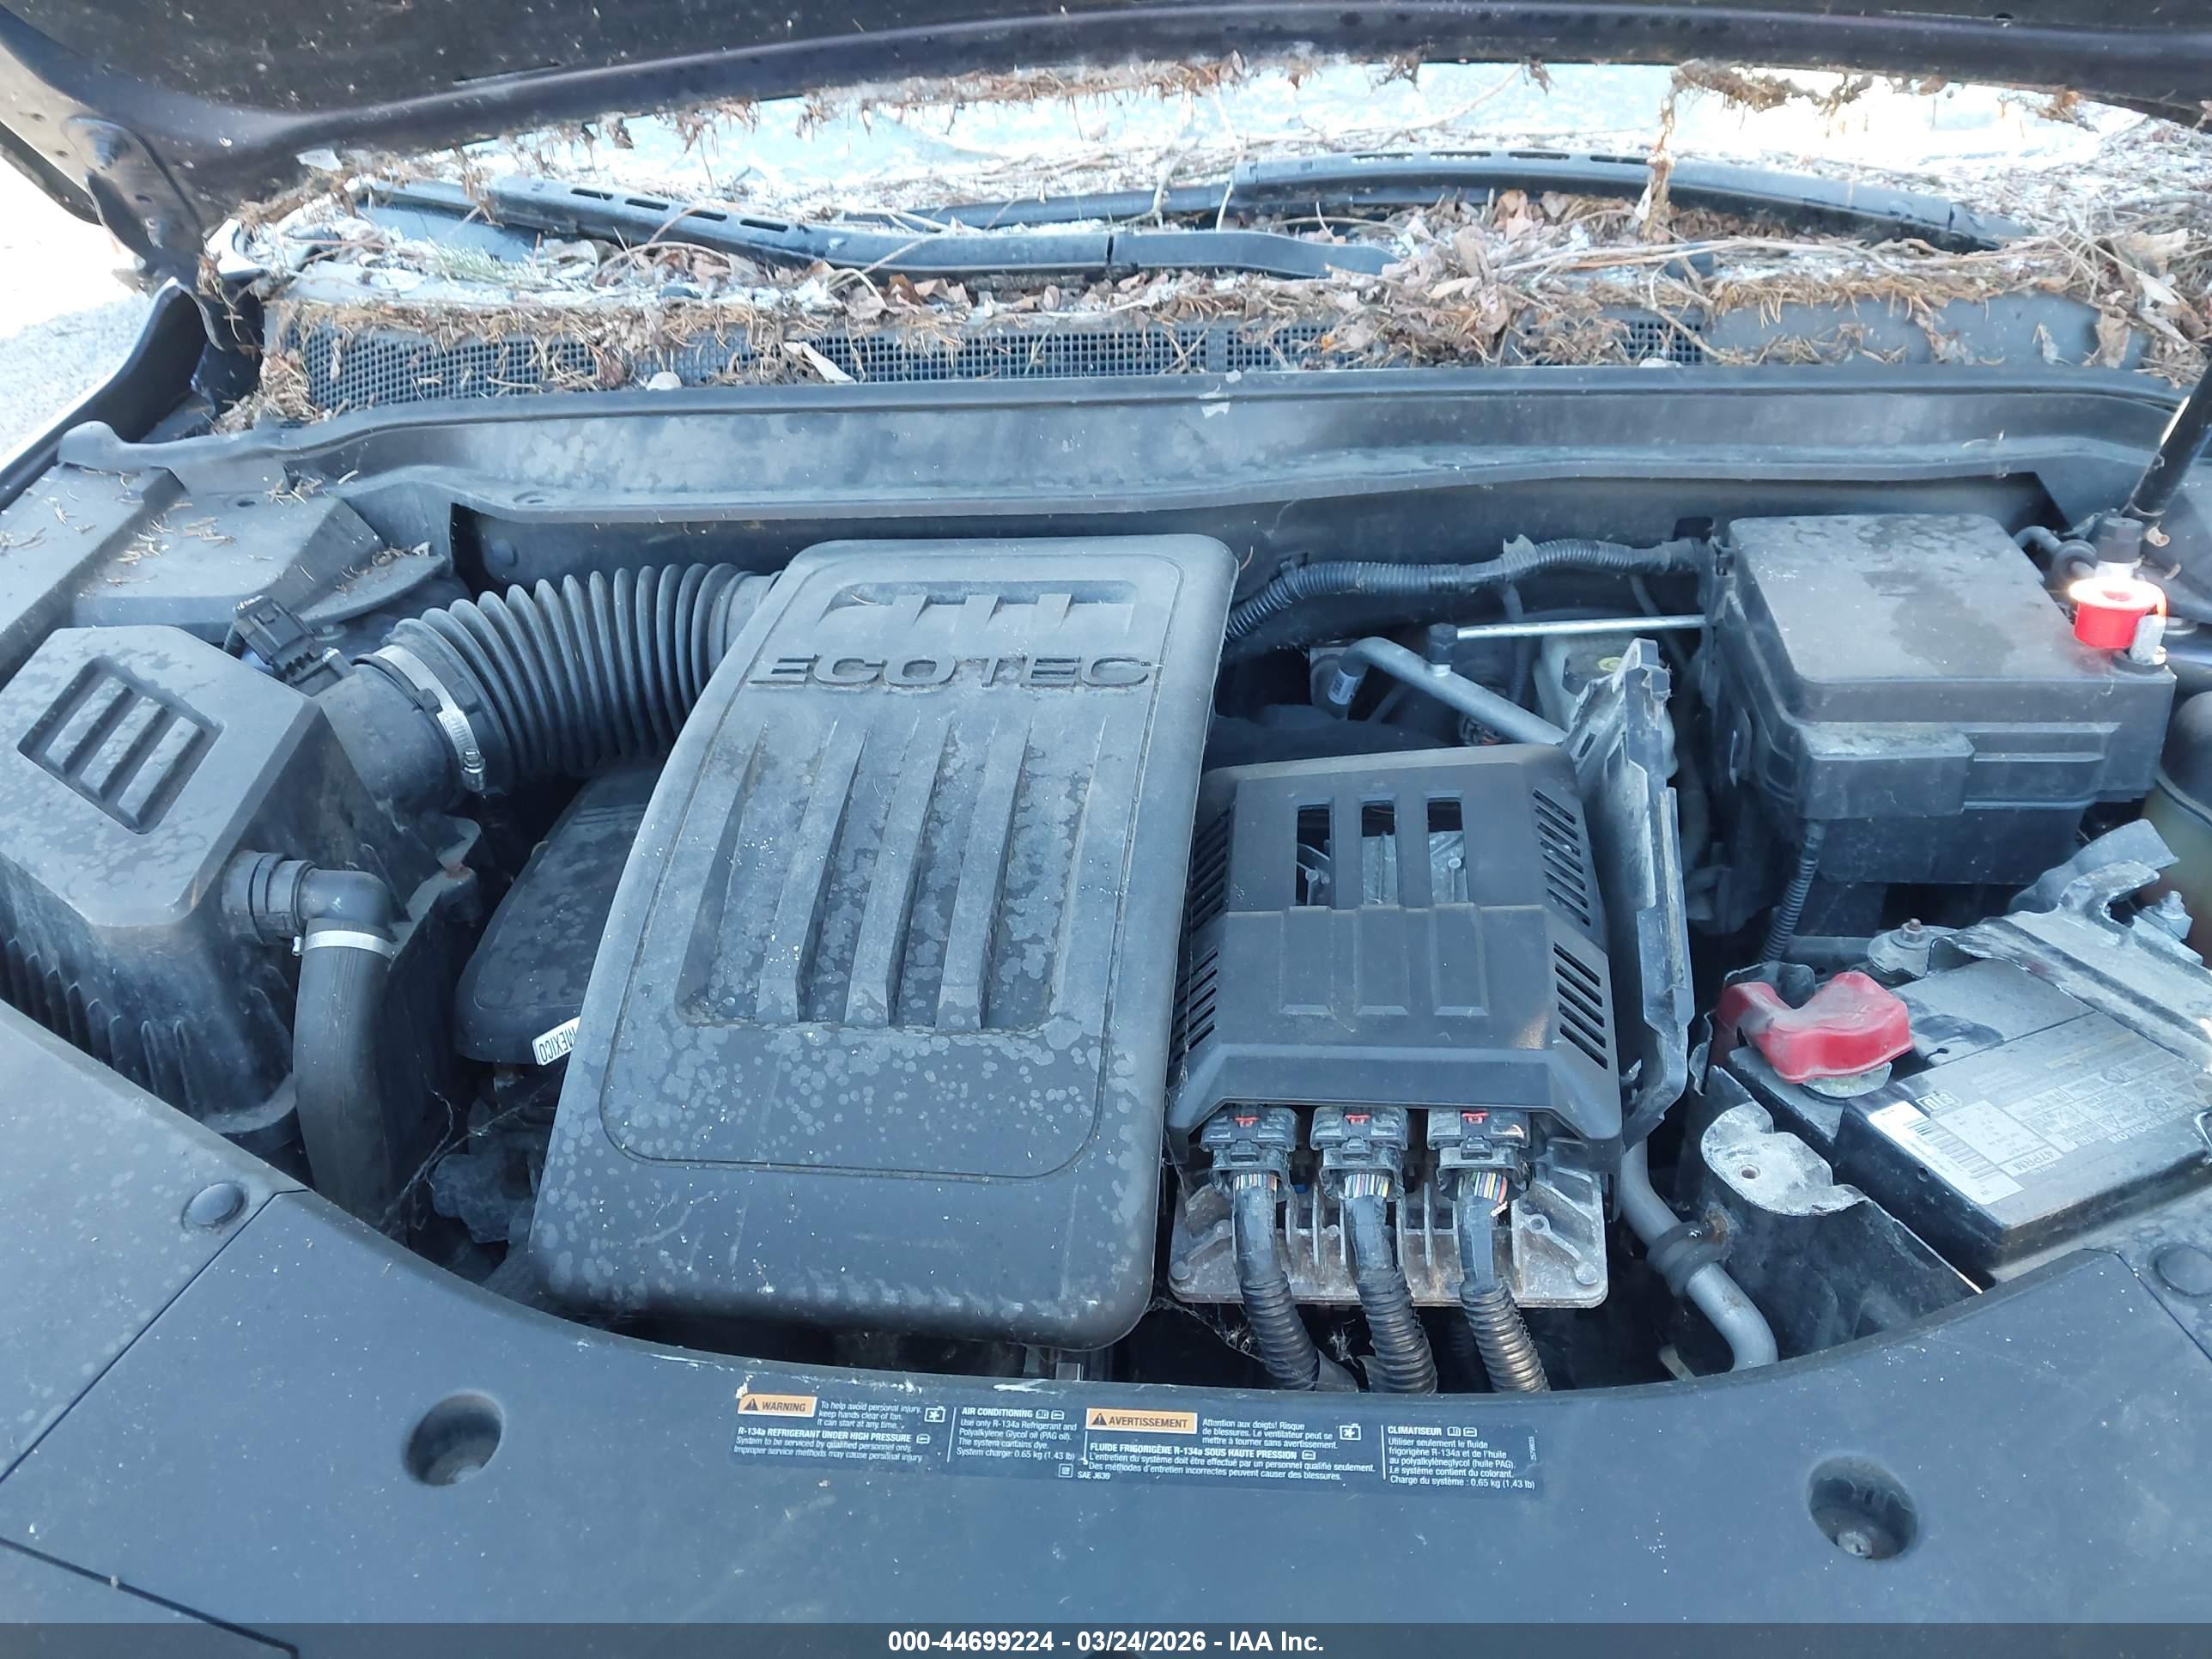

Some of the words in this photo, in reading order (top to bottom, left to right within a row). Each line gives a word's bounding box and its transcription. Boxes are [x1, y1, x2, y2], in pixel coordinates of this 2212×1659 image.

[749, 653, 1155, 688] ECOTEC
[539, 1027, 576, 1062] MEXICO
[2012, 1149, 2054, 1171] 47PRM
[762, 1401, 806, 1412] WARNING
[830, 1401, 846, 1410] help
[848, 1401, 867, 1410] avoid
[868, 1403, 898, 1412] personal
[819, 1410, 836, 1419] keep
[838, 1410, 860, 1419] hands
[977, 1408, 1033, 1419] CONDITIONING
[960, 1419, 974, 1427] Use
[975, 1419, 991, 1428] only
[993, 1420, 1019, 1429] R-134a
[1021, 1421, 1061, 1431] Refrigerant
[1063, 1423, 1077, 1431] and
[1109, 1416, 1188, 1429] AVERTISSEMENT
[1202, 1419, 1236, 1427] Attention
[1252, 1421, 1278, 1431] doigts!
[1279, 1422, 1305, 1431] Risque
[738, 1427, 766, 1436] R-134a
[767, 1428, 821, 1438] REFRIGERANT
[822, 1430, 848, 1439] UNDER
[850, 1431, 869, 1440] HIGH
[871, 1432, 912, 1443] PRESSURE
[958, 1428, 1005, 1438] Polyalkylene
[1006, 1430, 1028, 1439] Glycol
[1029, 1431, 1038, 1439] oil
[1039, 1431, 1057, 1441] (PAG
[1058, 1432, 1072, 1441] oil).
[1213, 1428, 1252, 1437] blessures.
[1264, 1431, 1304, 1439] ventilateur
[1305, 1432, 1322, 1441] peut
[1388, 1426, 1443, 1436] CLIMATISEUR
[736, 1436, 763, 1446] System
[773, 1437, 782, 1446] be
[785, 1438, 814, 1448] serviced
[816, 1440, 824, 1449] by
[826, 1441, 857, 1450] qualified
[859, 1443, 894, 1451] personnel
[958, 1437, 971, 1446] The
[974, 1439, 1000, 1449] system
[1001, 1439, 1032, 1449] contains
[1034, 1441, 1049, 1451] dye.
[1235, 1438, 1261, 1447] tourner
[1283, 1441, 1338, 1449] avertissement.
[1388, 1437, 1415, 1446] Utiliser
[1417, 1438, 1456, 1448] seulement
[1467, 1440, 1489, 1449] fluide
[733, 1445, 766, 1455] Improper
[768, 1448, 793, 1456] service
[795, 1448, 826, 1457] methods
[828, 1450, 845, 1460] may
[869, 1451, 900, 1461] personal
[957, 1447, 984, 1456] System
[1014, 1449, 1031, 1458] 0.65
[1032, 1451, 1042, 1460] kg
[1044, 1451, 1064, 1461] (1.43
[1065, 1452, 1075, 1462] lb)
[1090, 1443, 1118, 1451] FLUIDE
[1174, 1446, 1202, 1455] R-134a
[1204, 1448, 1226, 1456] SOUS
[1228, 1448, 1255, 1458] HAUTE
[1256, 1449, 1297, 1460] PRESSION
[1389, 1446, 1430, 1457] frigorigène
[1431, 1448, 1460, 1457] R-134a
[1462, 1449, 1471, 1458] et
[1472, 1449, 1482, 1458] de
[1140, 1455, 1173, 1465] système
[1175, 1456, 1188, 1465] doit
[1190, 1456, 1206, 1465] être
[1206, 1457, 1238, 1467] effectué
[1239, 1460, 1252, 1468] par
[1266, 1462, 1303, 1470] personnel
[1304, 1462, 1332, 1471] qualifié
[1333, 1463, 1376, 1472] seulement.
[1401, 1456, 1470, 1468] polyalkylèneglycol
[1472, 1459, 1494, 1468] (huile
[1496, 1460, 1516, 1469] PAG).
[1093, 1472, 1111, 1480] J639
[1104, 1462, 1142, 1472] méthodes
[1185, 1467, 1228, 1477] incorrectes
[1228, 1469, 1259, 1478] peuvent
[1261, 1470, 1286, 1479] causer
[1288, 1470, 1303, 1479] des
[1304, 1472, 1341, 1480] blessures.
[1401, 1466, 1433, 1476] système
[1436, 1468, 1467, 1477] contient
[1468, 1468, 1479, 1477] du
[1480, 1468, 1514, 1479] colorant.
[1390, 1475, 1418, 1486] Charge
[1419, 1476, 1430, 1485] du
[1431, 1477, 1464, 1487] système
[1470, 1479, 1489, 1487] 0,65
[1491, 1480, 1501, 1489] kg
[1503, 1480, 1523, 1489] (1,43
[1525, 1480, 1535, 1491] lb)
